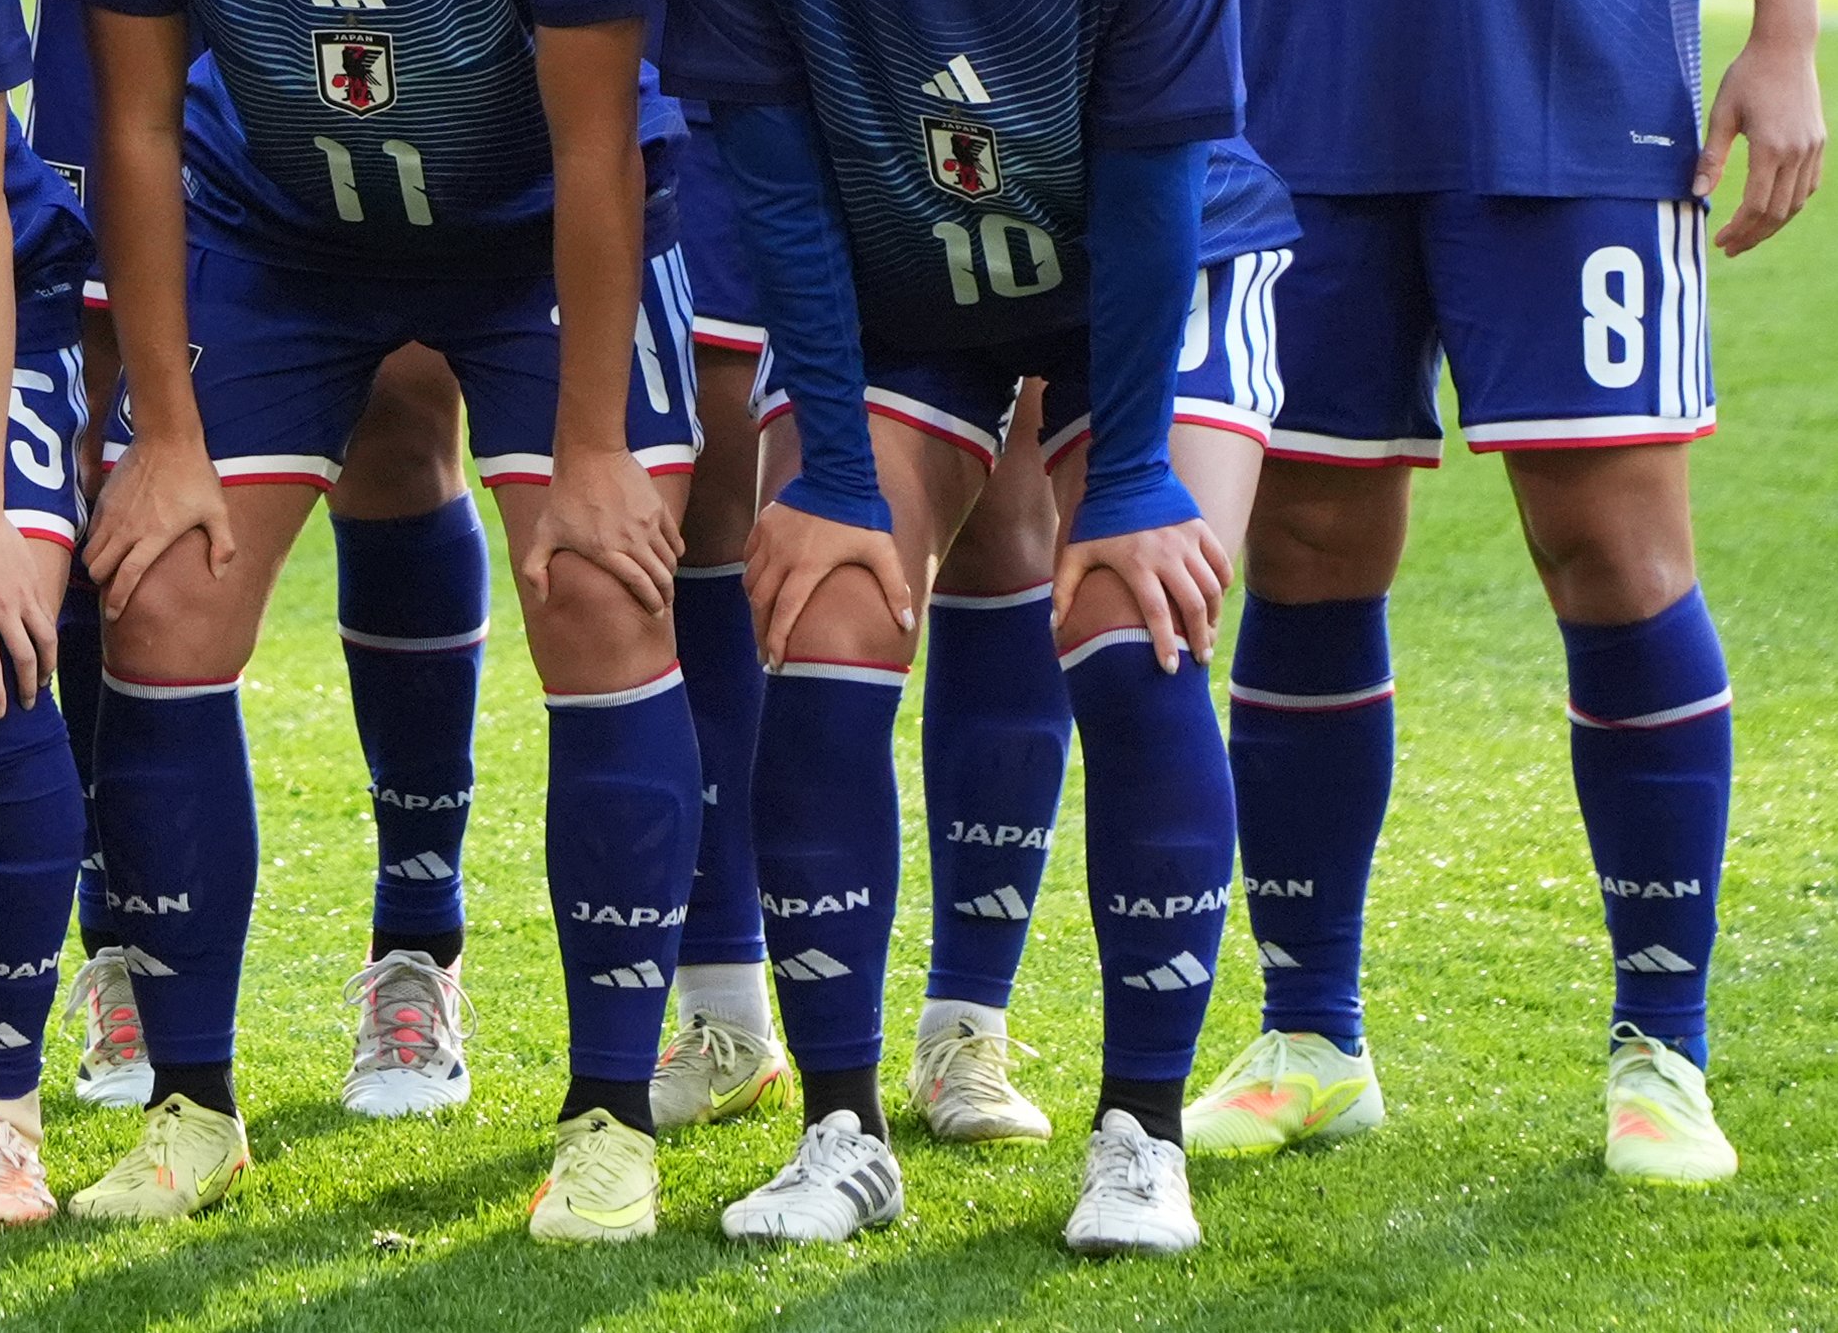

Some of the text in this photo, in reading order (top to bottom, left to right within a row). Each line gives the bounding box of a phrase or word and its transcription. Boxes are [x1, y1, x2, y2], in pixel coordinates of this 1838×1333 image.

[333, 33, 373, 43] JAPAN
[942, 122, 979, 134] JAPAN
[314, 136, 433, 226] 11
[932, 214, 1063, 305] 10
[1582, 246, 1644, 388] 8
[8, 368, 65, 490] 5
[1109, 881, 1232, 920] JAPAN
[1243, 876, 1313, 897] PAN
[1600, 876, 1701, 898] APAN
[106, 888, 191, 915] PAN
[572, 902, 688, 928] JAPAN
[758, 886, 870, 918] APAN
